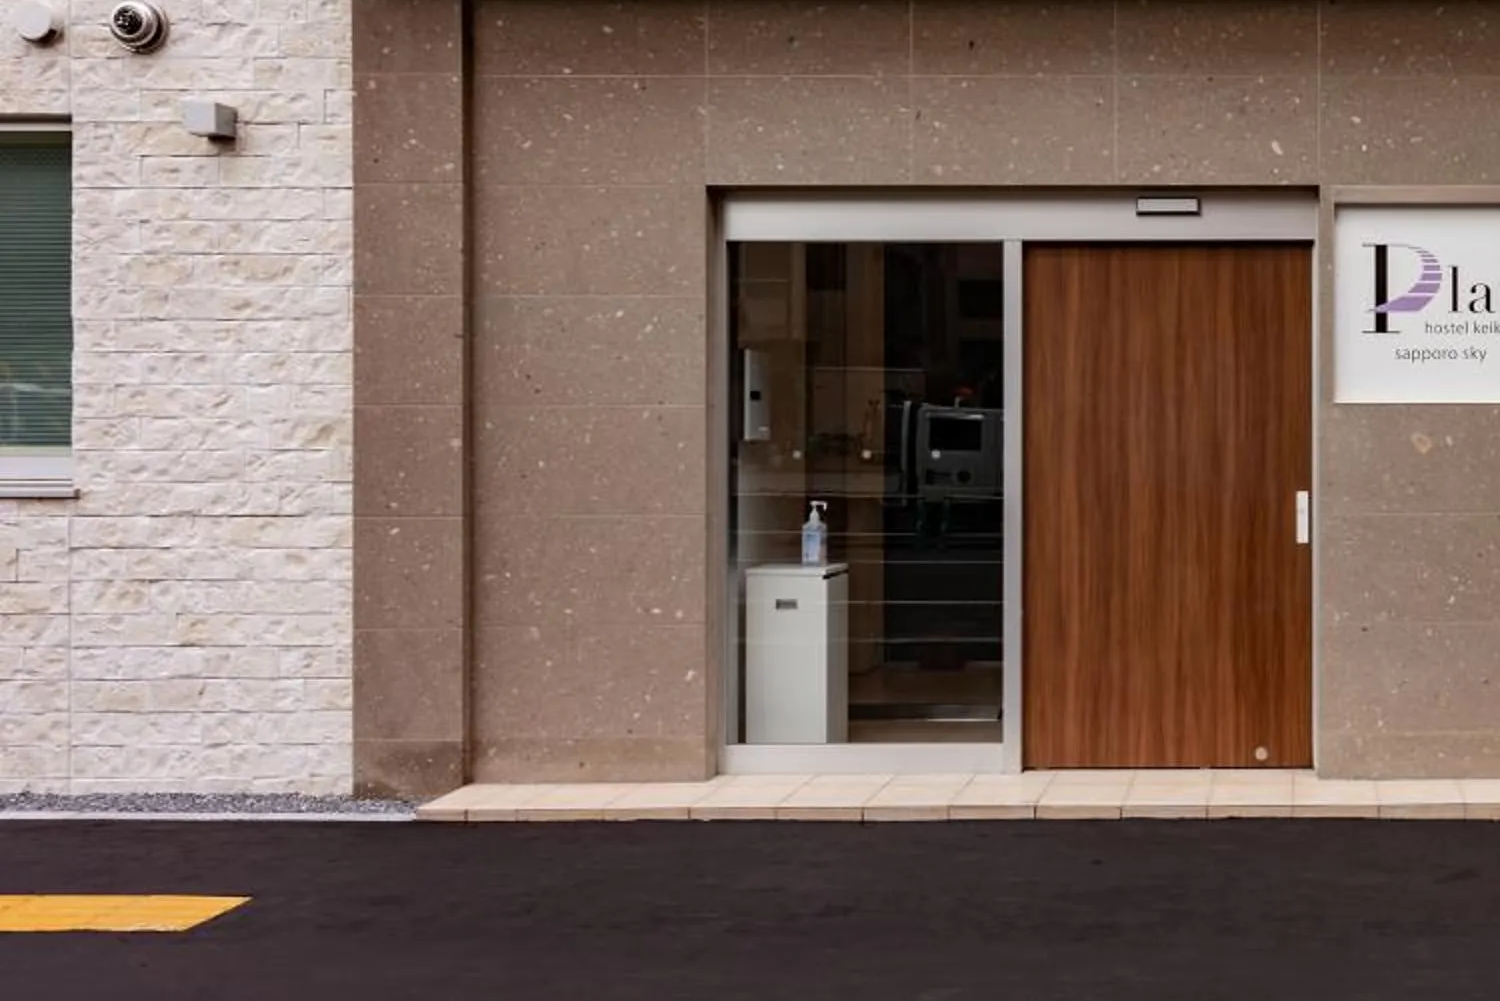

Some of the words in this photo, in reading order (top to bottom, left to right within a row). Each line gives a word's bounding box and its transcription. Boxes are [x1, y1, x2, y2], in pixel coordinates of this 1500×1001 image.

[1424, 321, 1469, 335] hostel
[1394, 347, 1459, 363] sapporo
[1463, 346, 1488, 362] sky
